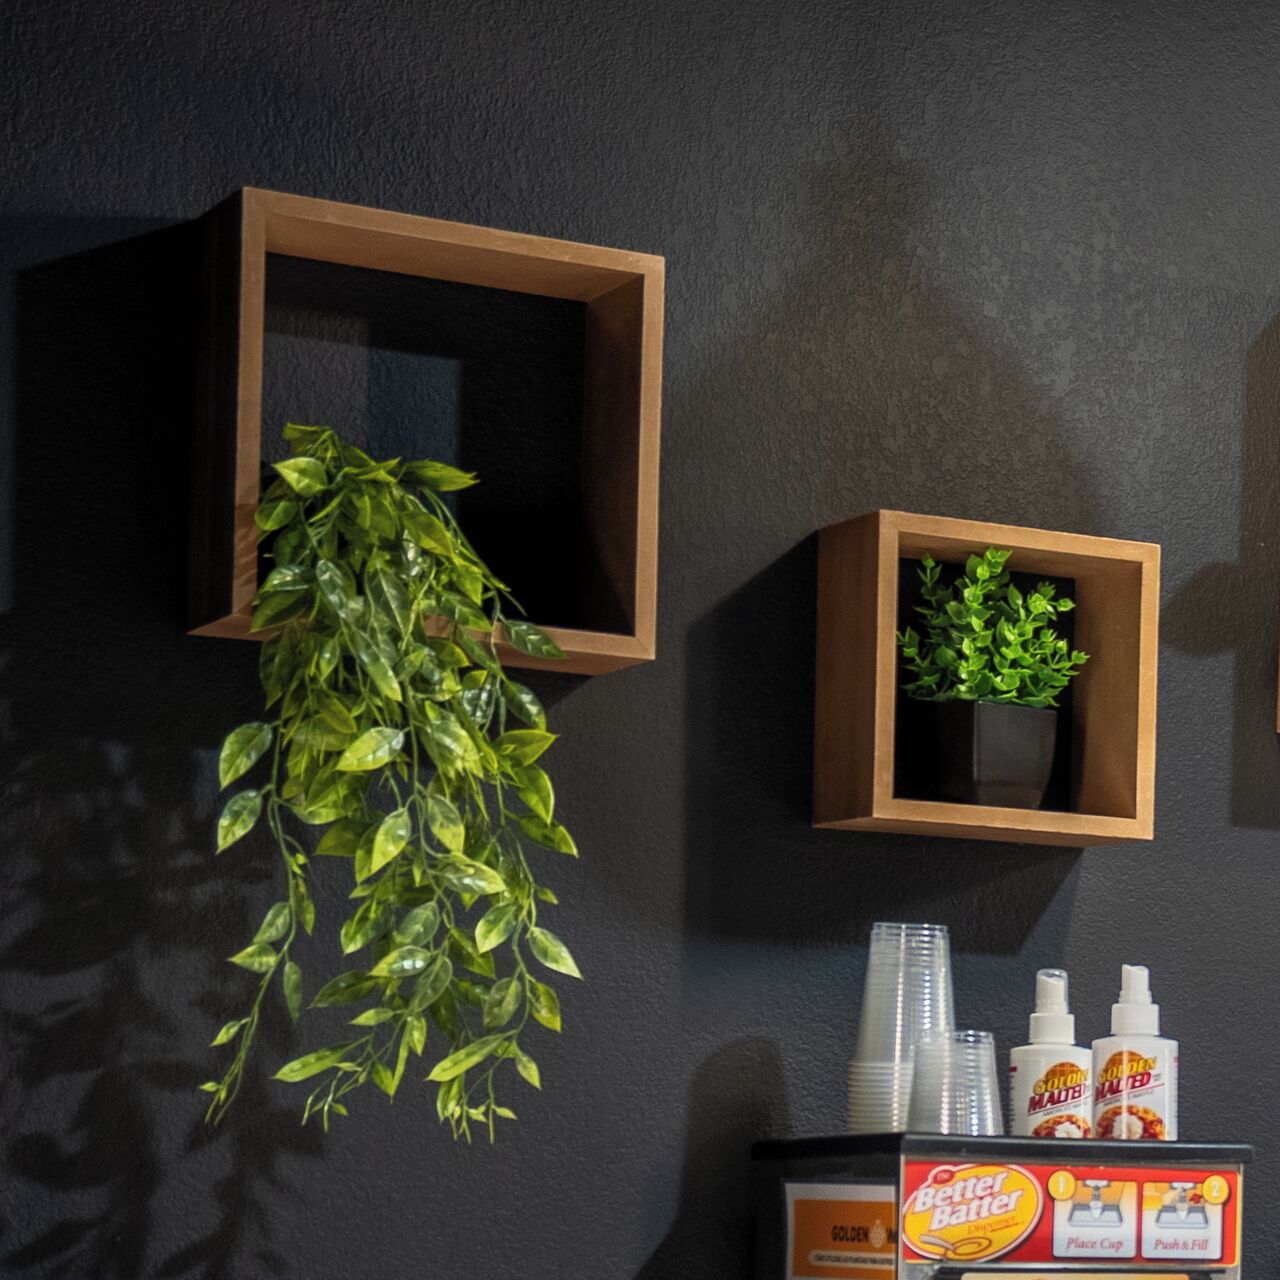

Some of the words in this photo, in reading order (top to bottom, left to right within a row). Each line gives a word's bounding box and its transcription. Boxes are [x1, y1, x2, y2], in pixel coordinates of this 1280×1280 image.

[912, 1169, 1010, 1214] Better
[1058, 1177, 1065, 1194] 1
[1211, 1181, 1221, 1198] 2
[928, 1188, 1024, 1232] Batter
[831, 1225, 868, 1243] GOLDEN
[1066, 1237, 1097, 1251] Place
[1099, 1237, 1124, 1252] Cup
[1154, 1238, 1180, 1251] Push
[1190, 1238, 1209, 1251] Fill
